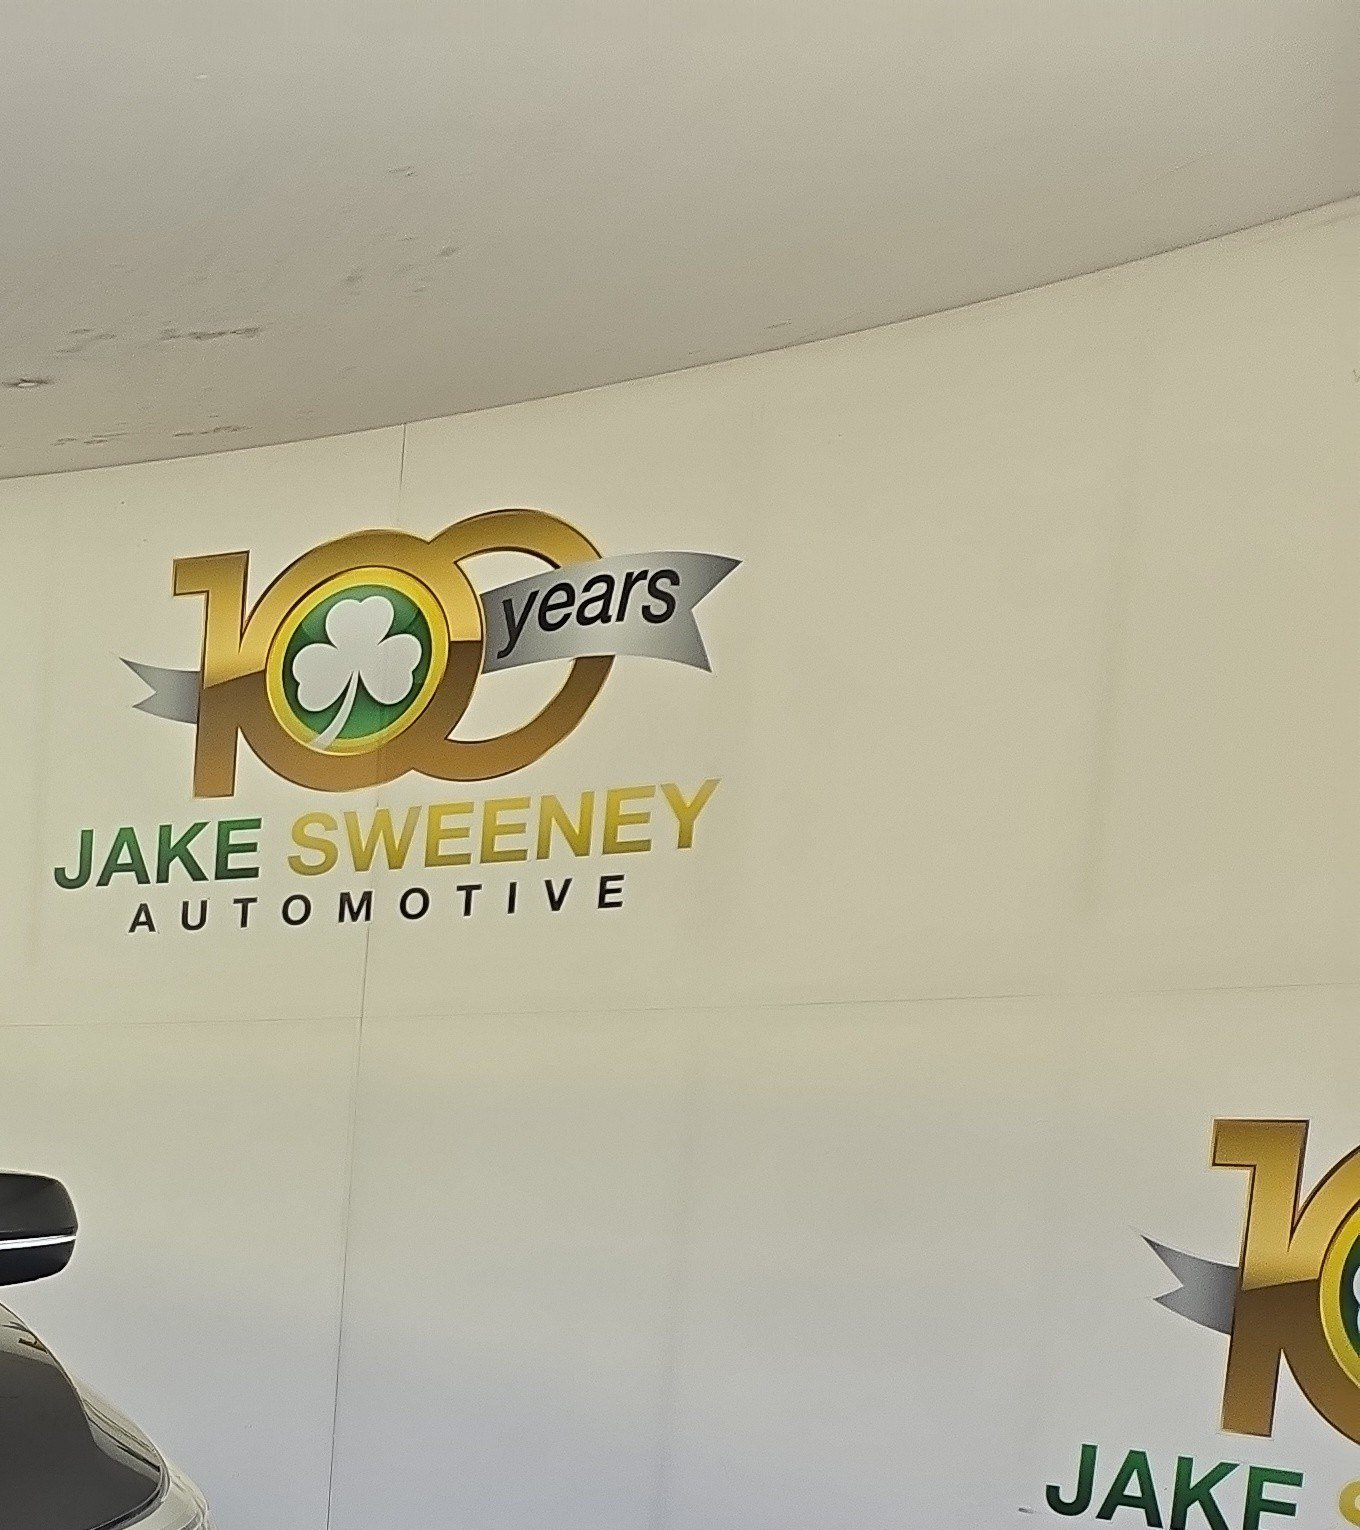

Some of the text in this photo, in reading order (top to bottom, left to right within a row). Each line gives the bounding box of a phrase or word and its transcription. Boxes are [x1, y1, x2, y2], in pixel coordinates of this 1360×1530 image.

[497, 565, 681, 659] years
[54, 777, 723, 890] JAKE SWEENEY
[128, 874, 626, 934] AUTOMOTIVE
